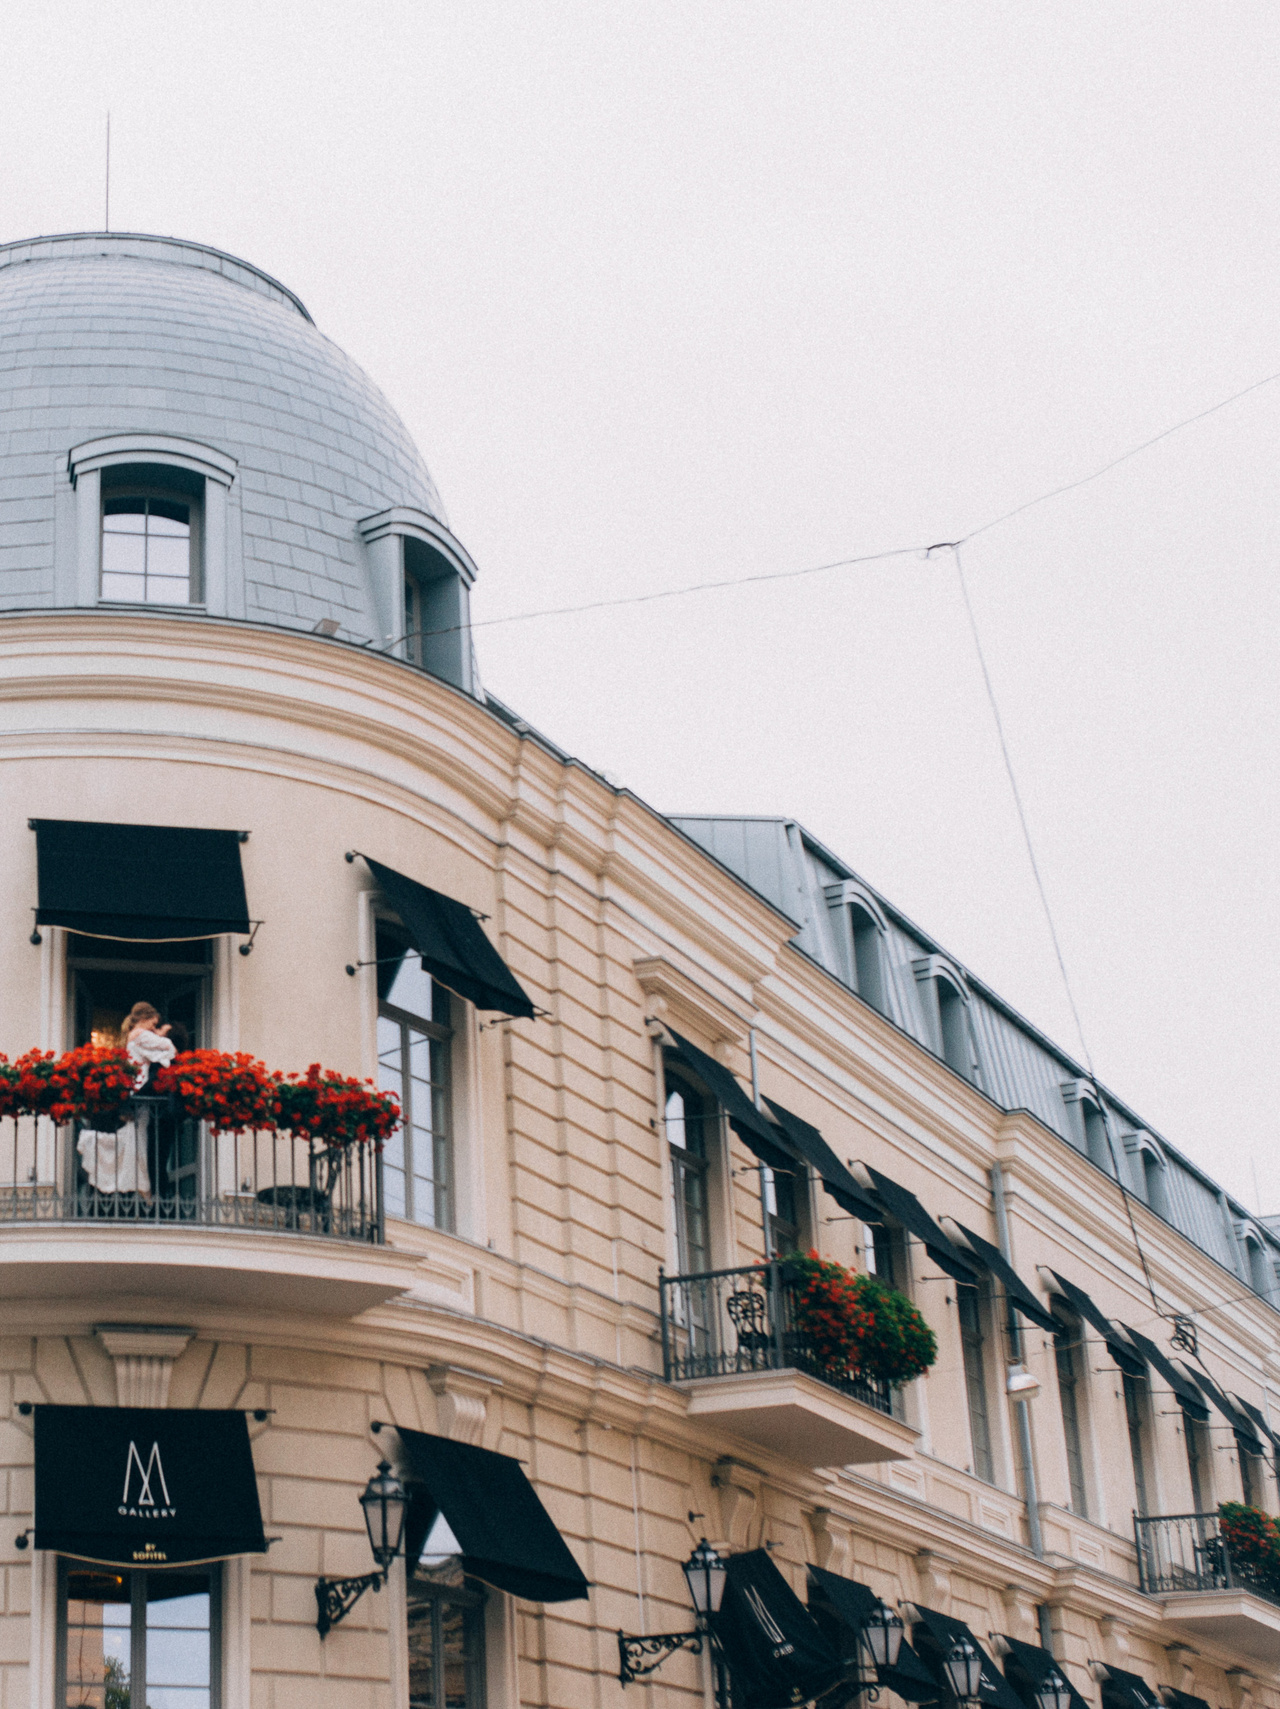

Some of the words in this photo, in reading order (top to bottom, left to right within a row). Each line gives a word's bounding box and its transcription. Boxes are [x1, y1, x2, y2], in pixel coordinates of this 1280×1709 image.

[118, 1506, 176, 1518] GALLERY
[145, 1543, 156, 1551] BY
[133, 1551, 167, 1560] SOFITEL
